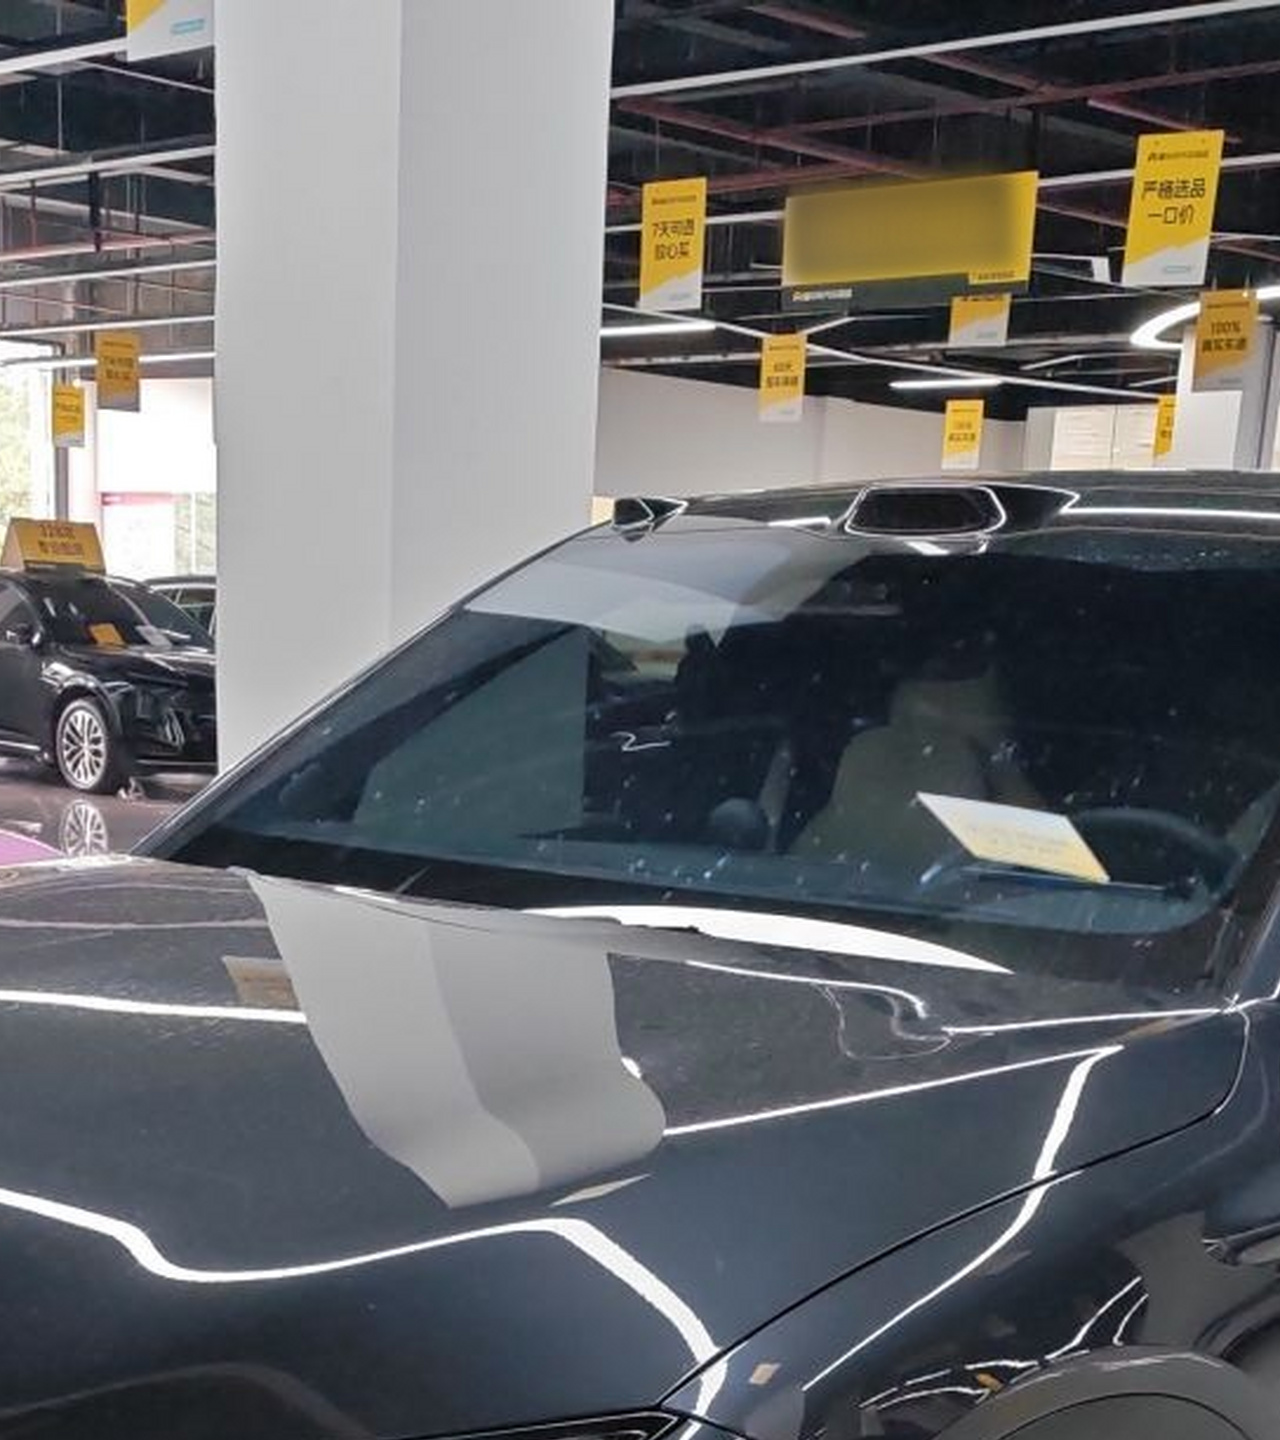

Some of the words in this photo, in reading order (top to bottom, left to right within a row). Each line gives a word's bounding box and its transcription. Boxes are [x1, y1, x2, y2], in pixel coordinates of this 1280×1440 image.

[1141, 177, 1206, 201] 严格选品
[1148, 204, 1195, 225] 一口价
[652, 219, 695, 239] 7天可退
[655, 241, 690, 261] 放心买
[1211, 320, 1241, 334] 100%
